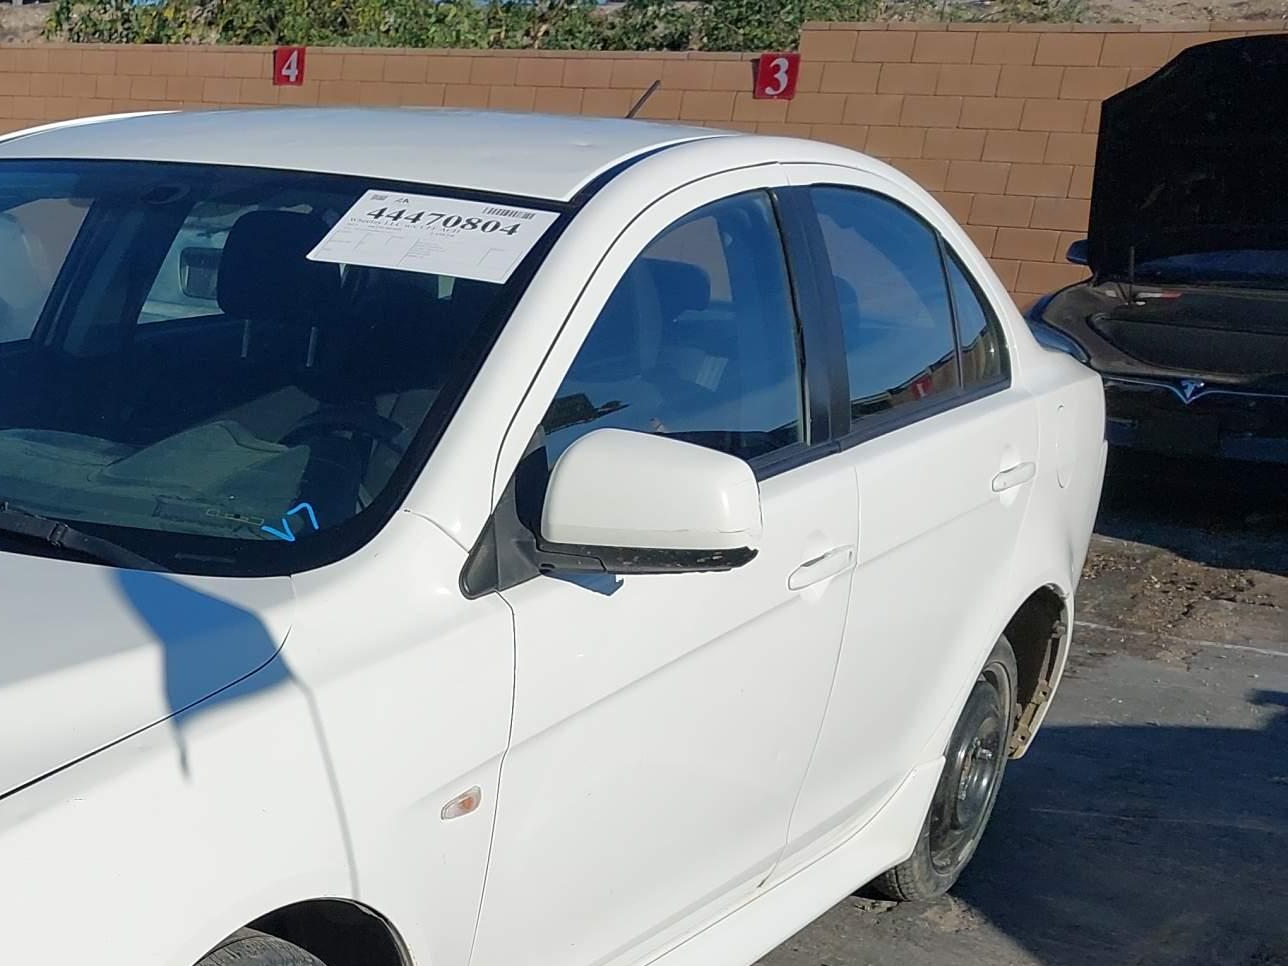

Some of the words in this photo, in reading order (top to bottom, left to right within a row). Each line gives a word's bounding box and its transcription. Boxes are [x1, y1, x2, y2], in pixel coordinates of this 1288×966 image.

[281, 49, 299, 82] 4
[765, 57, 789, 96] 3
[366, 206, 521, 236] 44470804
